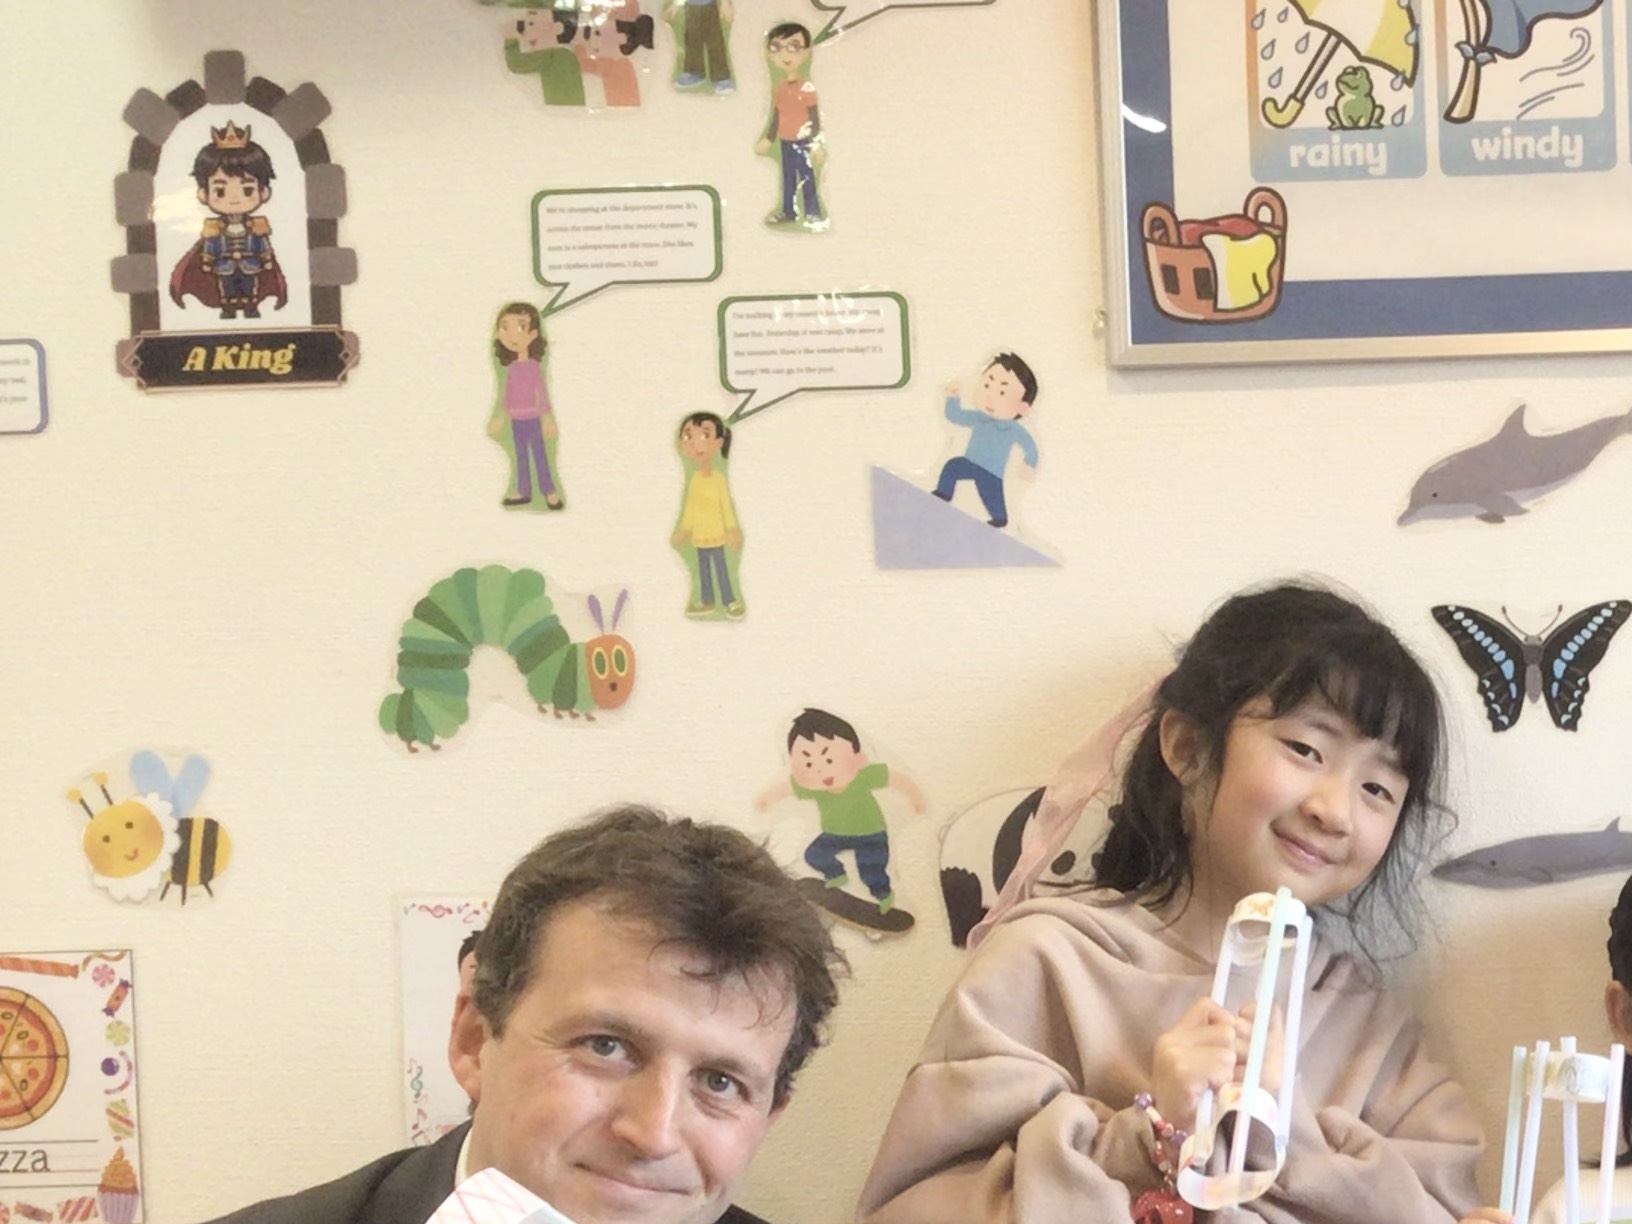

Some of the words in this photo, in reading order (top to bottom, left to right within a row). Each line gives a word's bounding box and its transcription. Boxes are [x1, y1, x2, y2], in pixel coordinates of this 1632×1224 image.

[1289, 135, 1388, 175] rainy
[1471, 125, 1584, 166] windy
[182, 346, 206, 371] A
[211, 343, 297, 375] King
